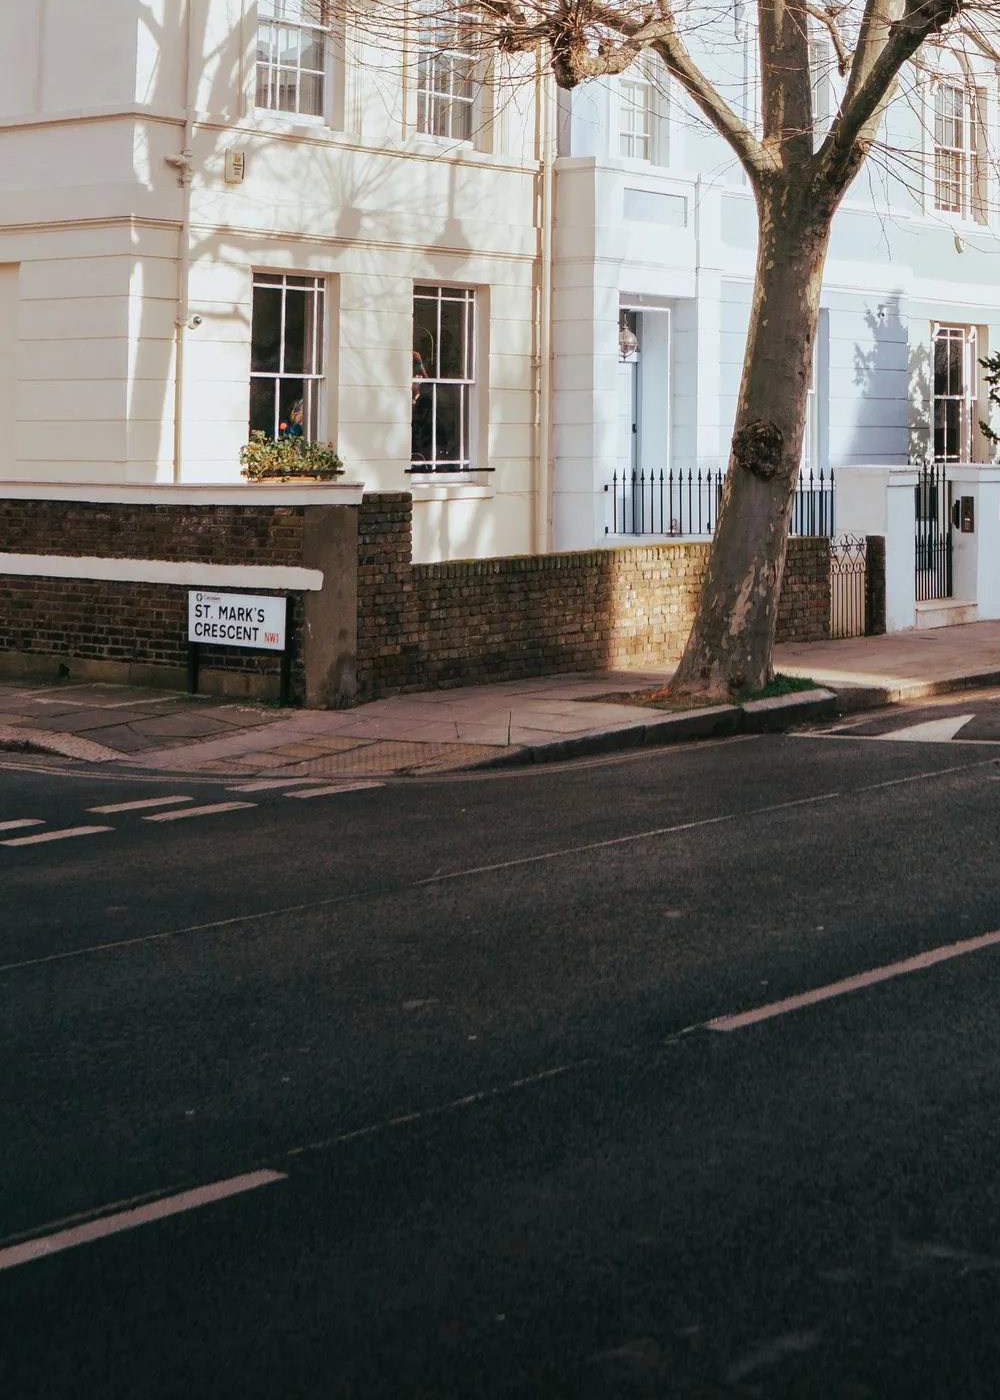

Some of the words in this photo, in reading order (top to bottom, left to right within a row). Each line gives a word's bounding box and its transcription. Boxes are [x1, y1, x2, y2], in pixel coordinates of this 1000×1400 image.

[195, 604, 214, 619] ST.
[218, 605, 265, 623] MARK'S
[194, 622, 259, 641] CRESCENT
[264, 632, 279, 643] NW1
